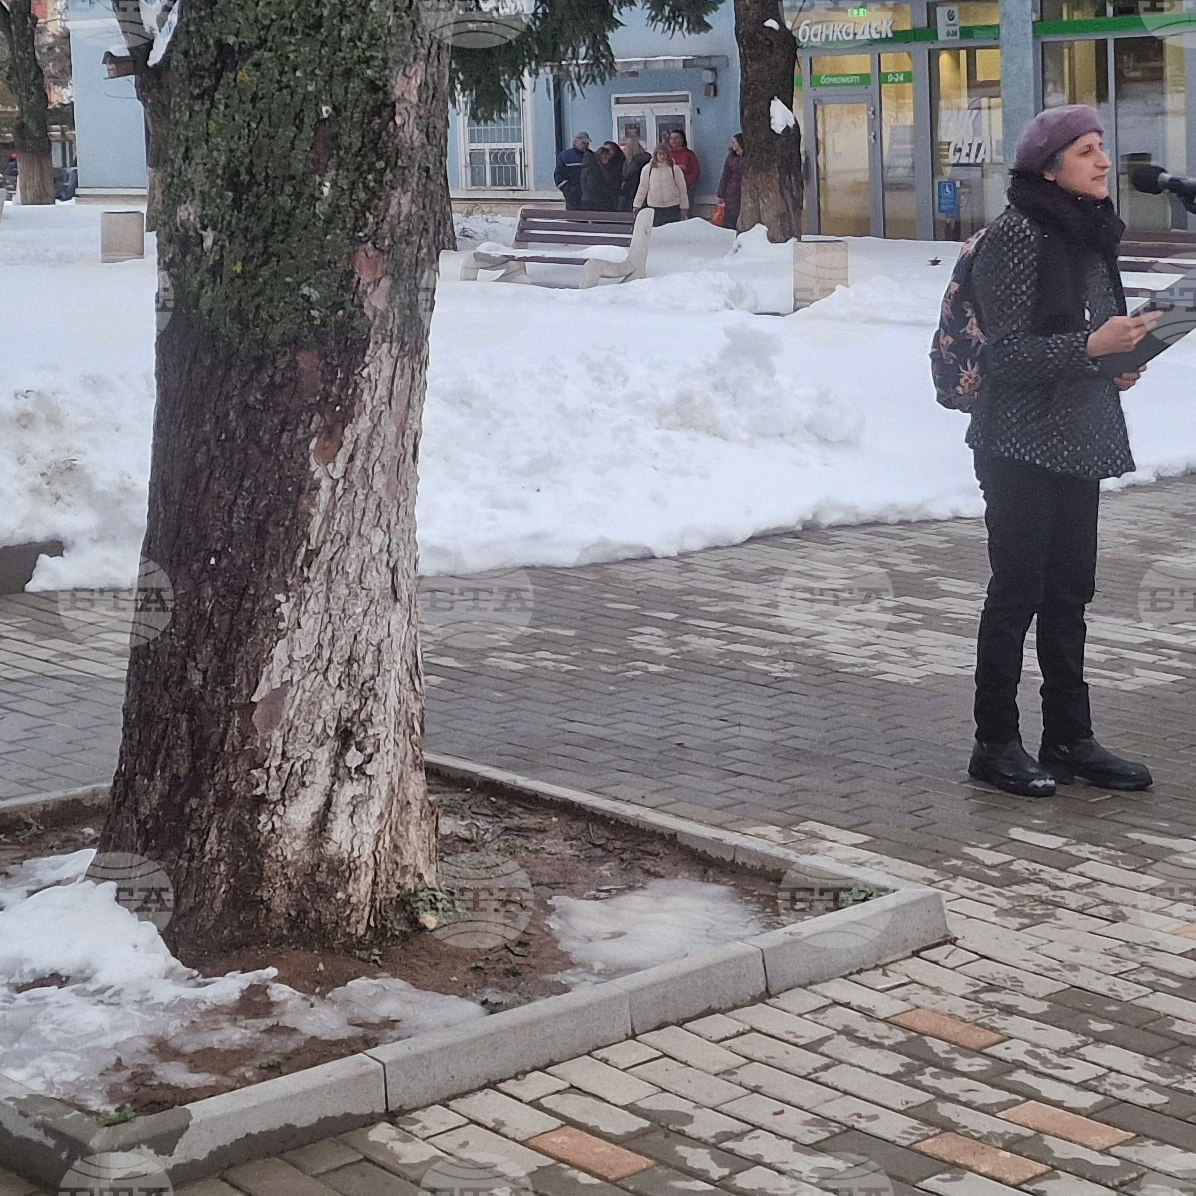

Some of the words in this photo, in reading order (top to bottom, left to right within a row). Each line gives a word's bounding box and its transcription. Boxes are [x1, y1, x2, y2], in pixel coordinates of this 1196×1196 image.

[798, 20, 855, 43] банка
[820, 75, 860, 85] банкомат
[887, 73, 904, 83] 0-24
